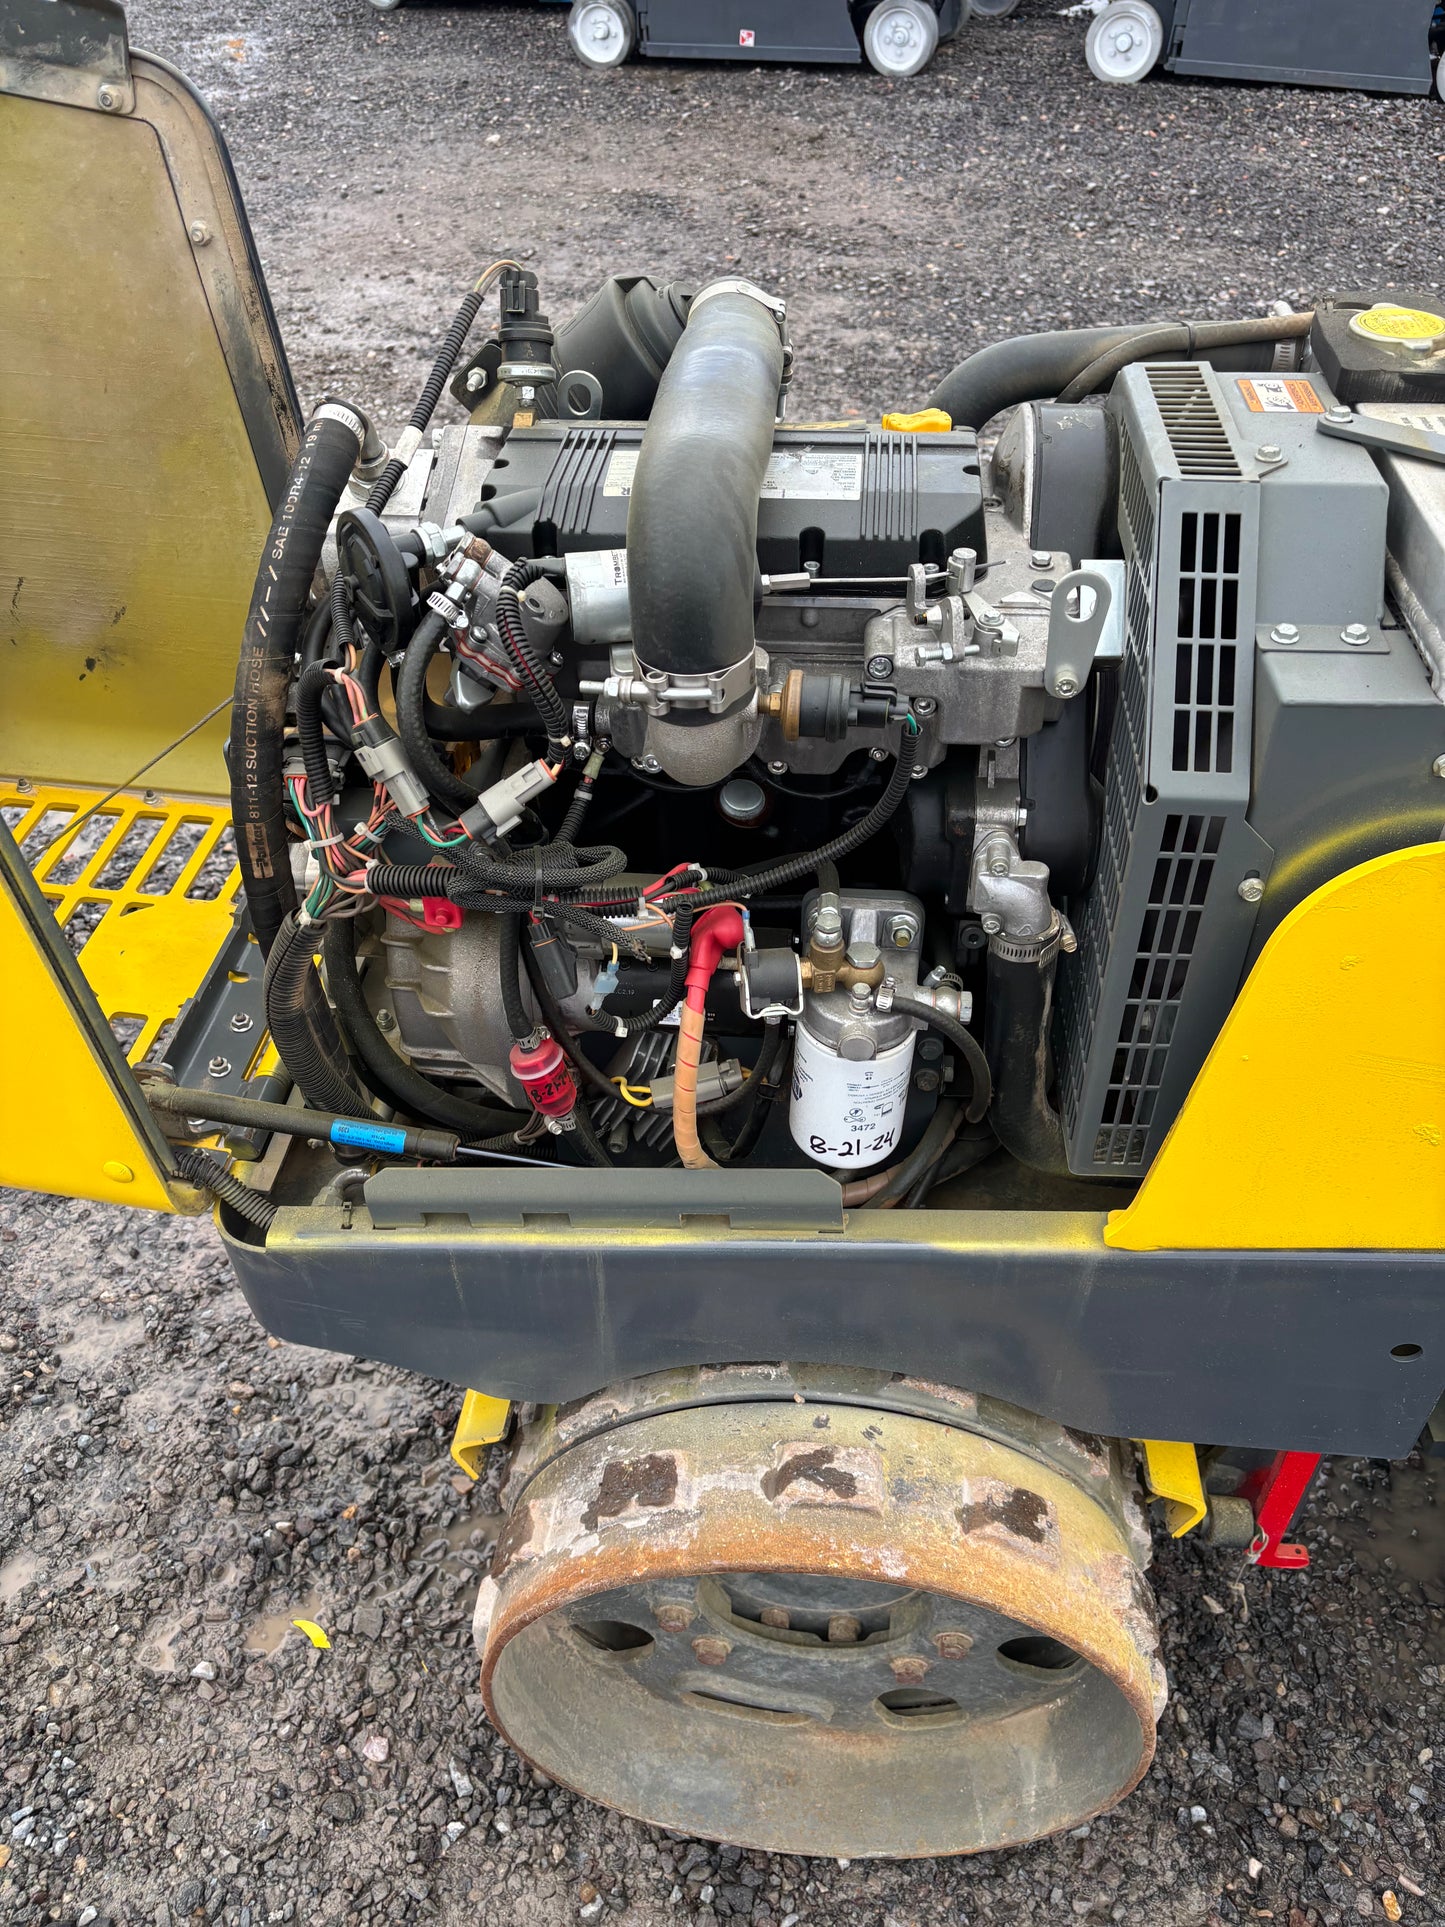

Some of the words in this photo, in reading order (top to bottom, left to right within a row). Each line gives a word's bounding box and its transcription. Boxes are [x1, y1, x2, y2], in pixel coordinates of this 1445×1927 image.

[271, 526, 289, 560] SAE
[282, 455, 311, 521] 100R4-12
[305, 434, 318, 449] 19
[312, 419, 324, 431] m
[250, 646, 264, 693] HOSE
[245, 698, 258, 769] SUCTION
[246, 773, 260, 819] 811-12
[249, 824, 269, 868] Parker
[809, 1127, 896, 1157] 8-21-24
[850, 1122, 876, 1133] 3472
